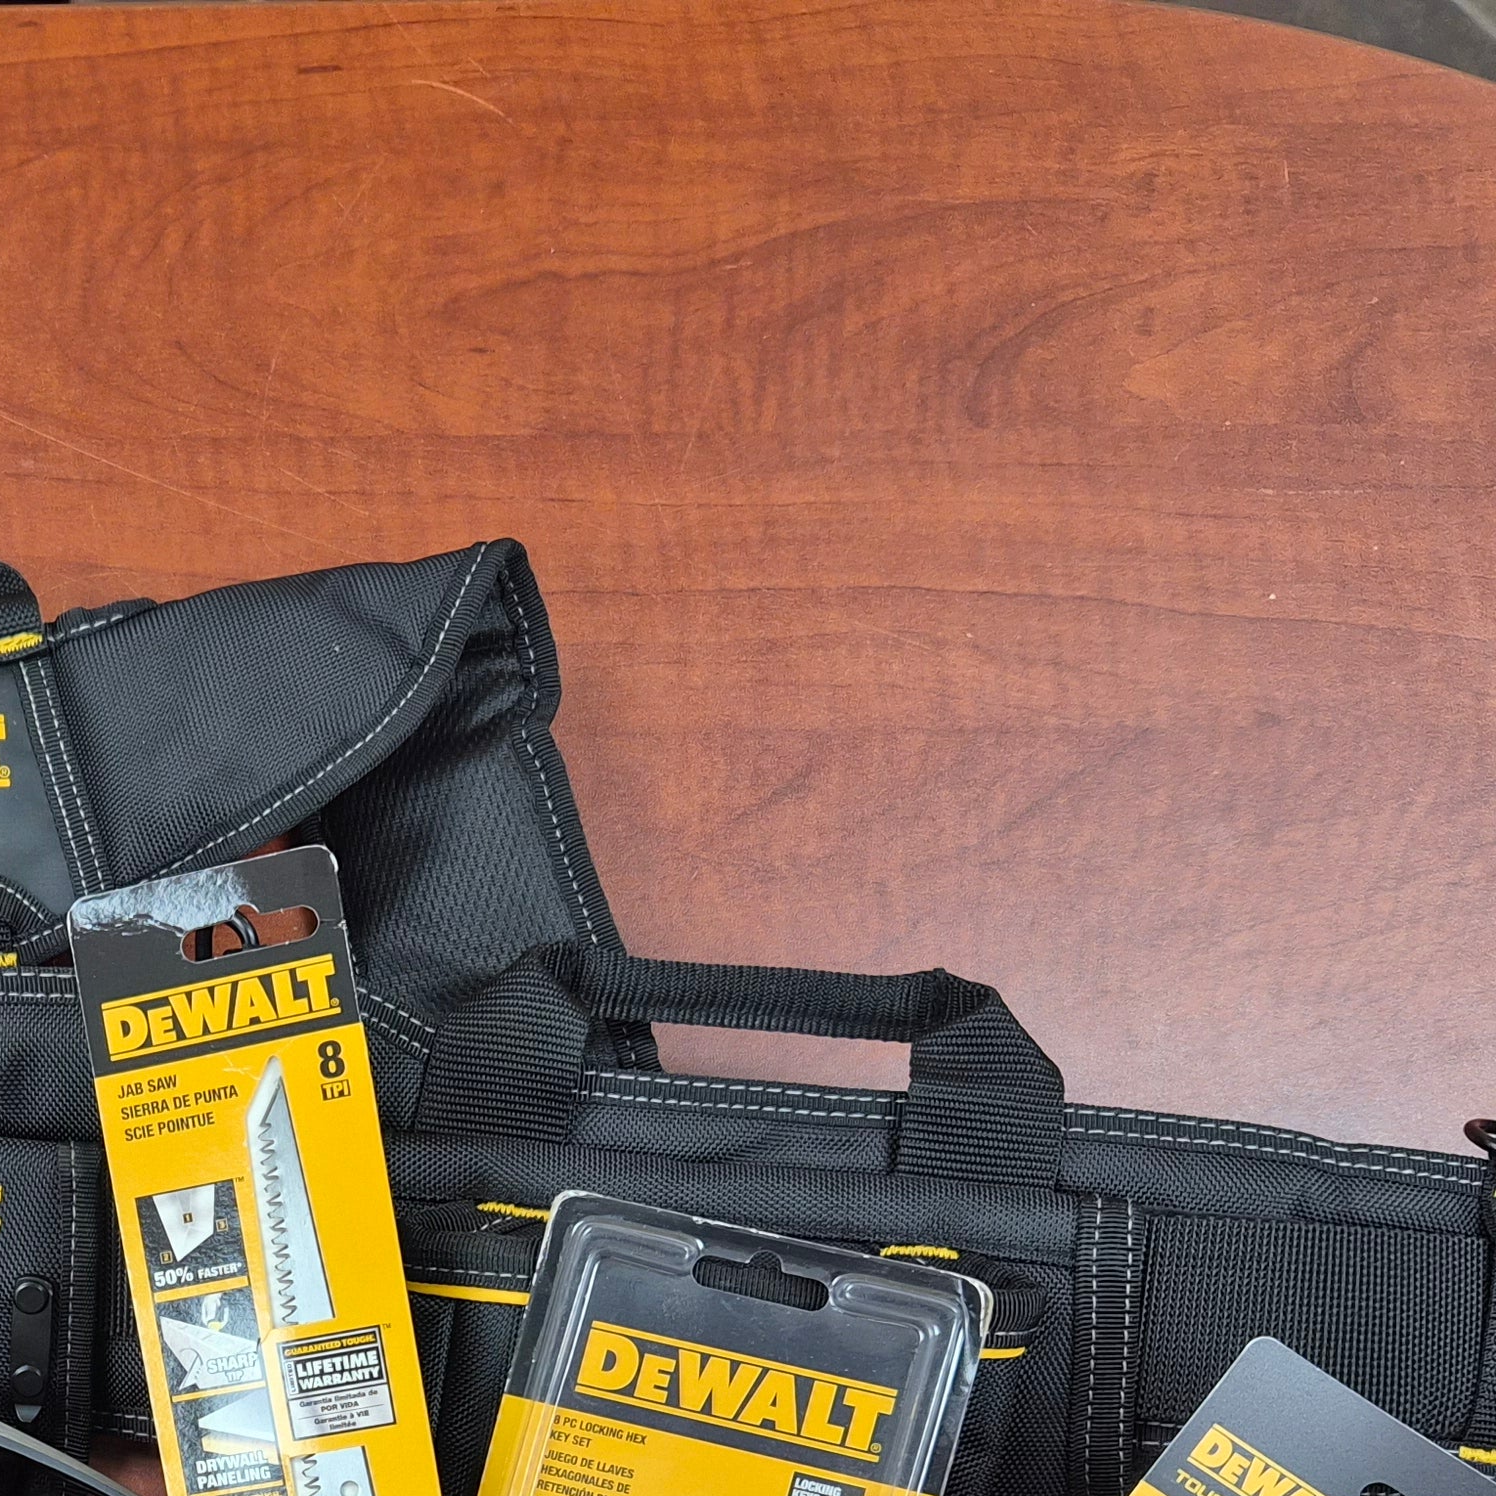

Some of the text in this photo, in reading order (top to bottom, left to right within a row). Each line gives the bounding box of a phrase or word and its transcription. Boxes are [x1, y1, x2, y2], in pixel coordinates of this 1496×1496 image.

[103, 960, 335, 1056] DEWALT
[318, 1040, 346, 1079] 8
[118, 1074, 177, 1099] JAB SAW
[323, 1081, 350, 1098] TPI
[121, 1084, 238, 1120] SIERRA DE PUNTA
[124, 1111, 215, 1142] SCIE POINTUE
[155, 1266, 194, 1288] 50%
[226, 1371, 243, 1381] TIP
[296, 1350, 379, 1377] LIFETIME
[299, 1366, 380, 1390] WARRANTY
[576, 1326, 895, 1457] DEWALT
[321, 1404, 338, 1412] POR
[549, 1430, 592, 1448] KEY SET
[554, 1415, 647, 1445] 8 PC LOCKING HEX
[196, 1451, 267, 1474] DRYWALL
[544, 1449, 635, 1479] JUEGO DE LLAVES
[198, 1466, 271, 1489] PANELING
[540, 1464, 631, 1494] HEXAGONALES DE
